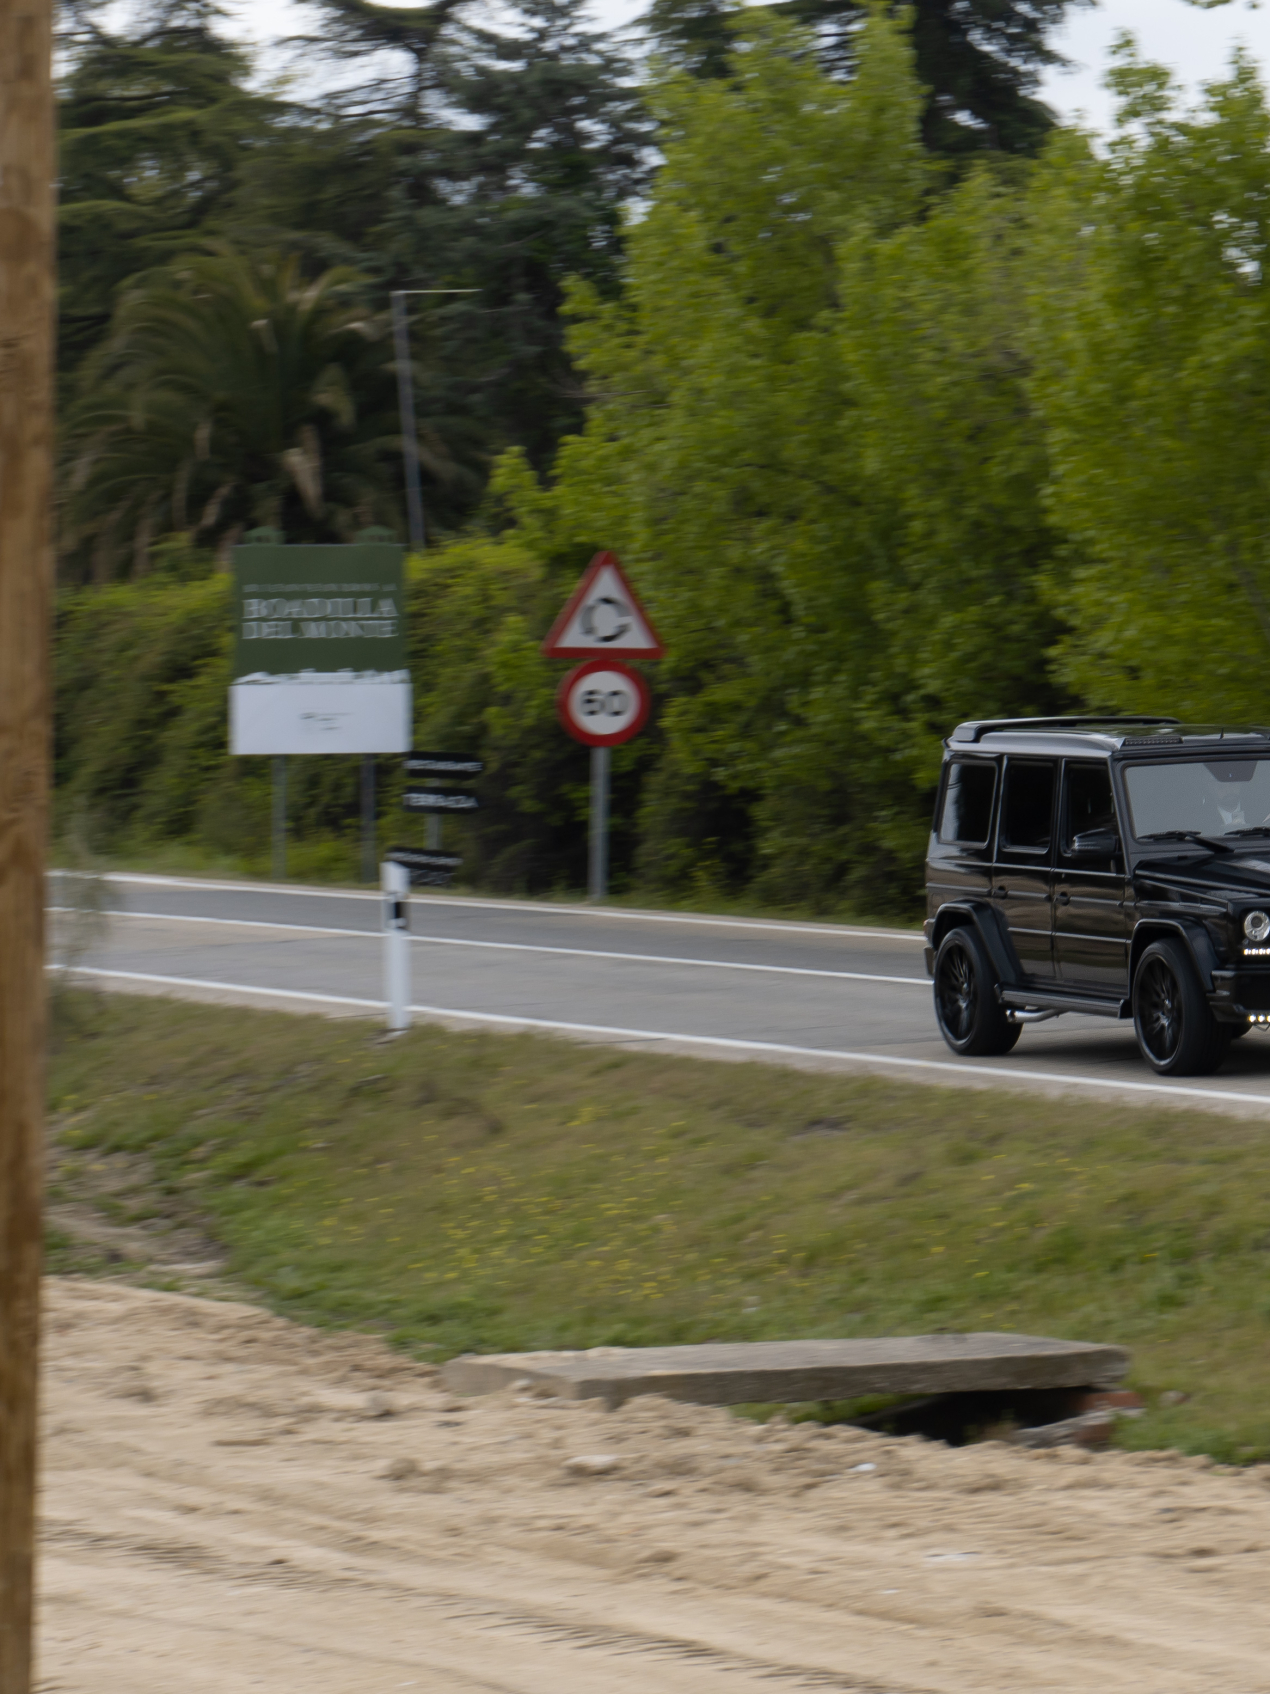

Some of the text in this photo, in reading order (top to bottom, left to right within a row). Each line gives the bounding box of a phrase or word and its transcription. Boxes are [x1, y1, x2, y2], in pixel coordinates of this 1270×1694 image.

[242, 598, 399, 618] BOADILLA
[242, 620, 399, 639] DEL MONTE
